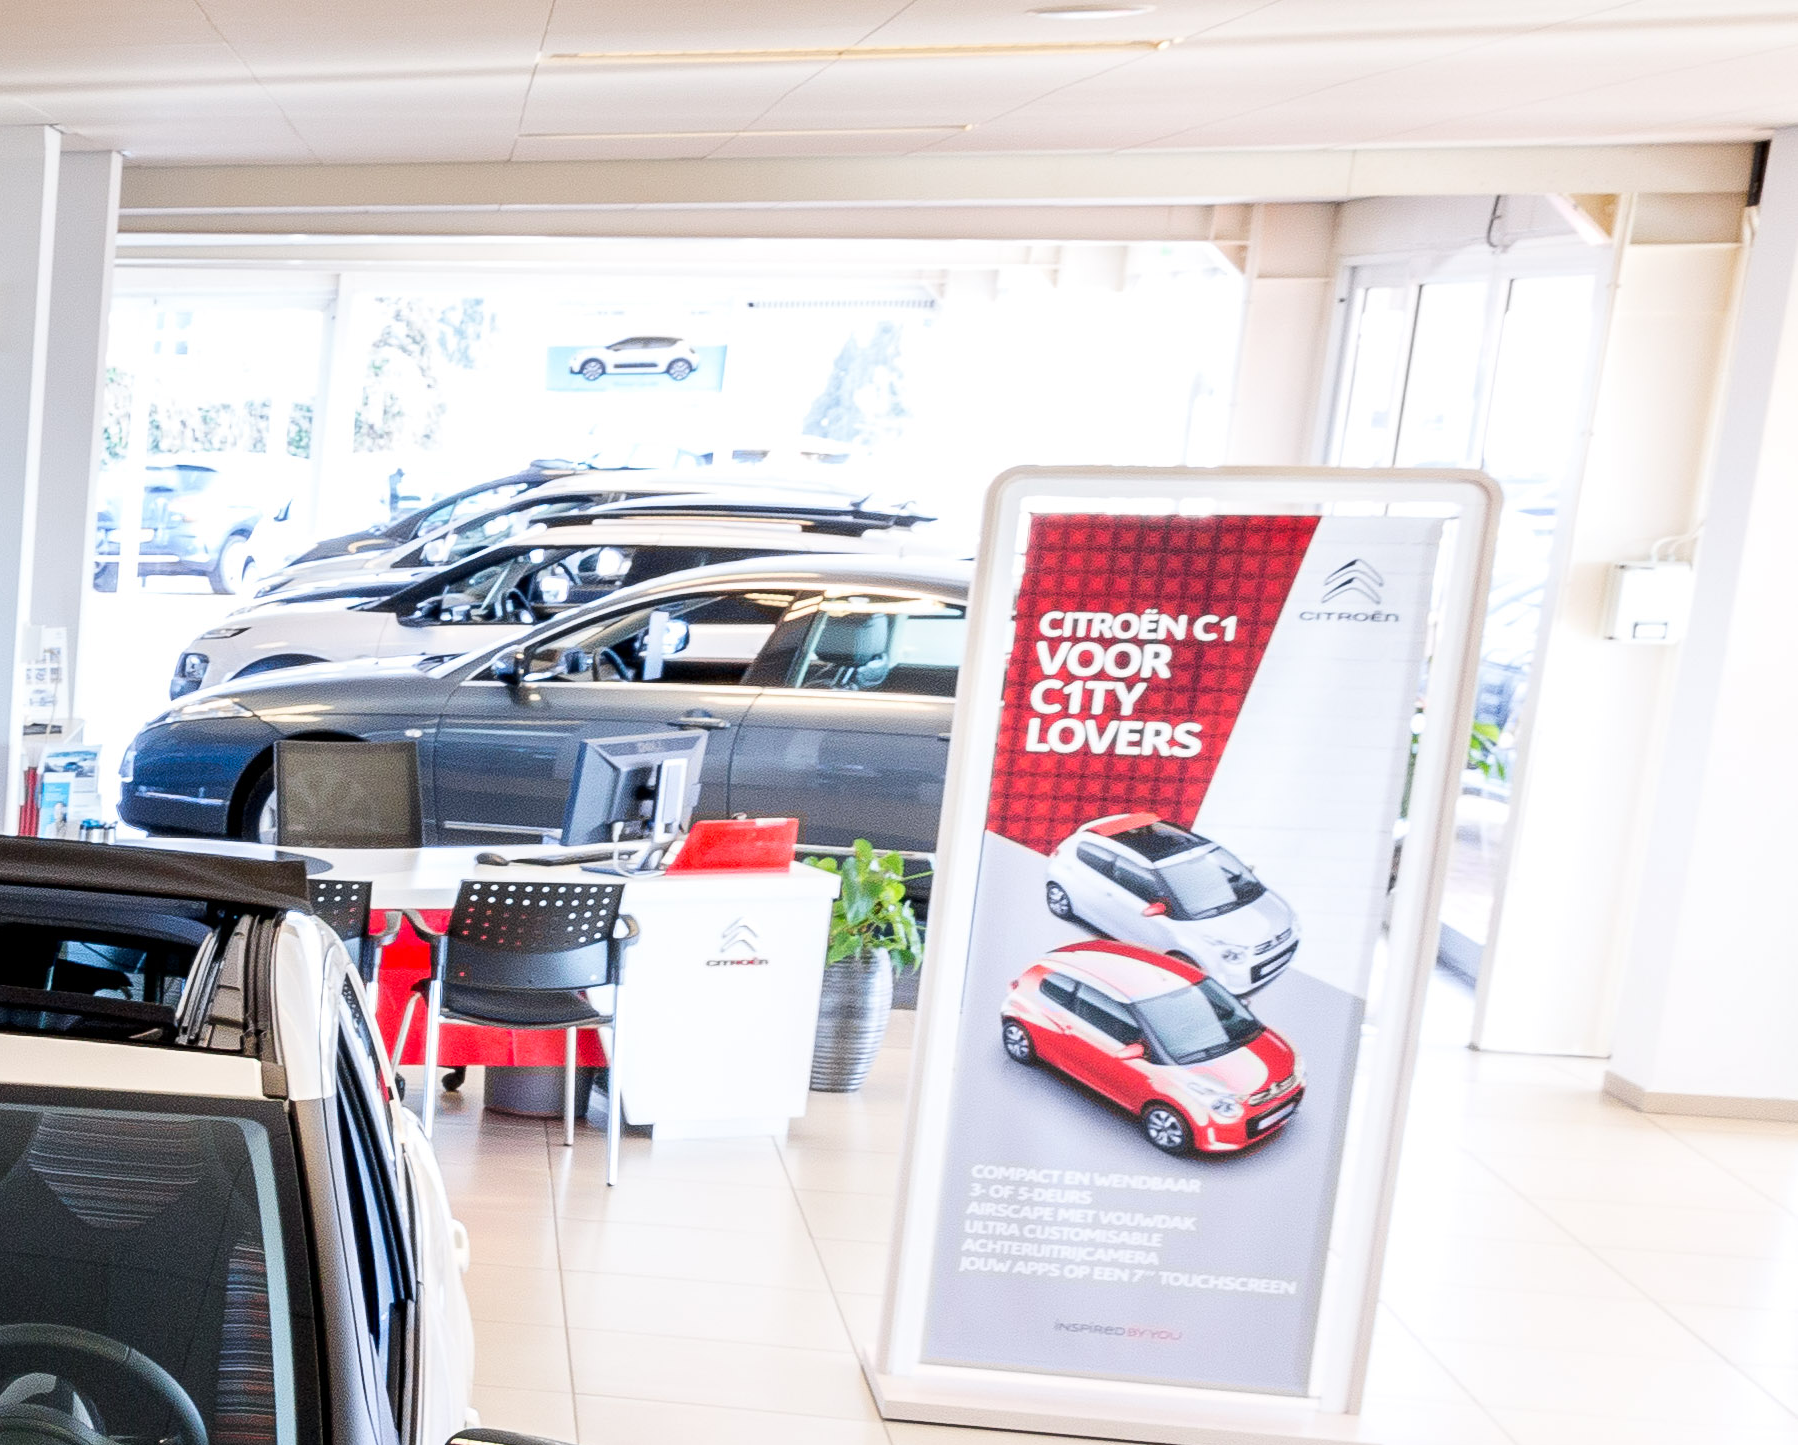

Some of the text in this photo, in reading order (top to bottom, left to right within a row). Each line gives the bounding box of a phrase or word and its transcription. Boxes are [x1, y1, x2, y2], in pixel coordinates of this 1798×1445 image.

[1039, 608, 1238, 642] CITROËN C1
[1299, 610, 1399, 622] CITROËN
[1036, 640, 1173, 679] VOOR
[1029, 678, 1148, 716] C1TY
[1025, 717, 1203, 758] LOVERS
[971, 1164, 1202, 1193] COMPACT EN WENDBAAR
[989, 1184, 1015, 1199] OF
[1017, 1186, 1094, 1205] 5-DEURS
[965, 1201, 1198, 1231] AIRSCAPE MET VOUWDAK
[964, 1219, 1164, 1247] ULTRA CUSTOMISABLE
[961, 1238, 1159, 1265] ACHTERUITRIJCAMERA
[958, 1256, 1013, 1273] JOUW
[1012, 1260, 1062, 1277] APPS
[1063, 1264, 1092, 1279] OP
[1092, 1266, 1130, 1282] EEN
[1159, 1270, 1298, 1295] TOUCHSCREEN
